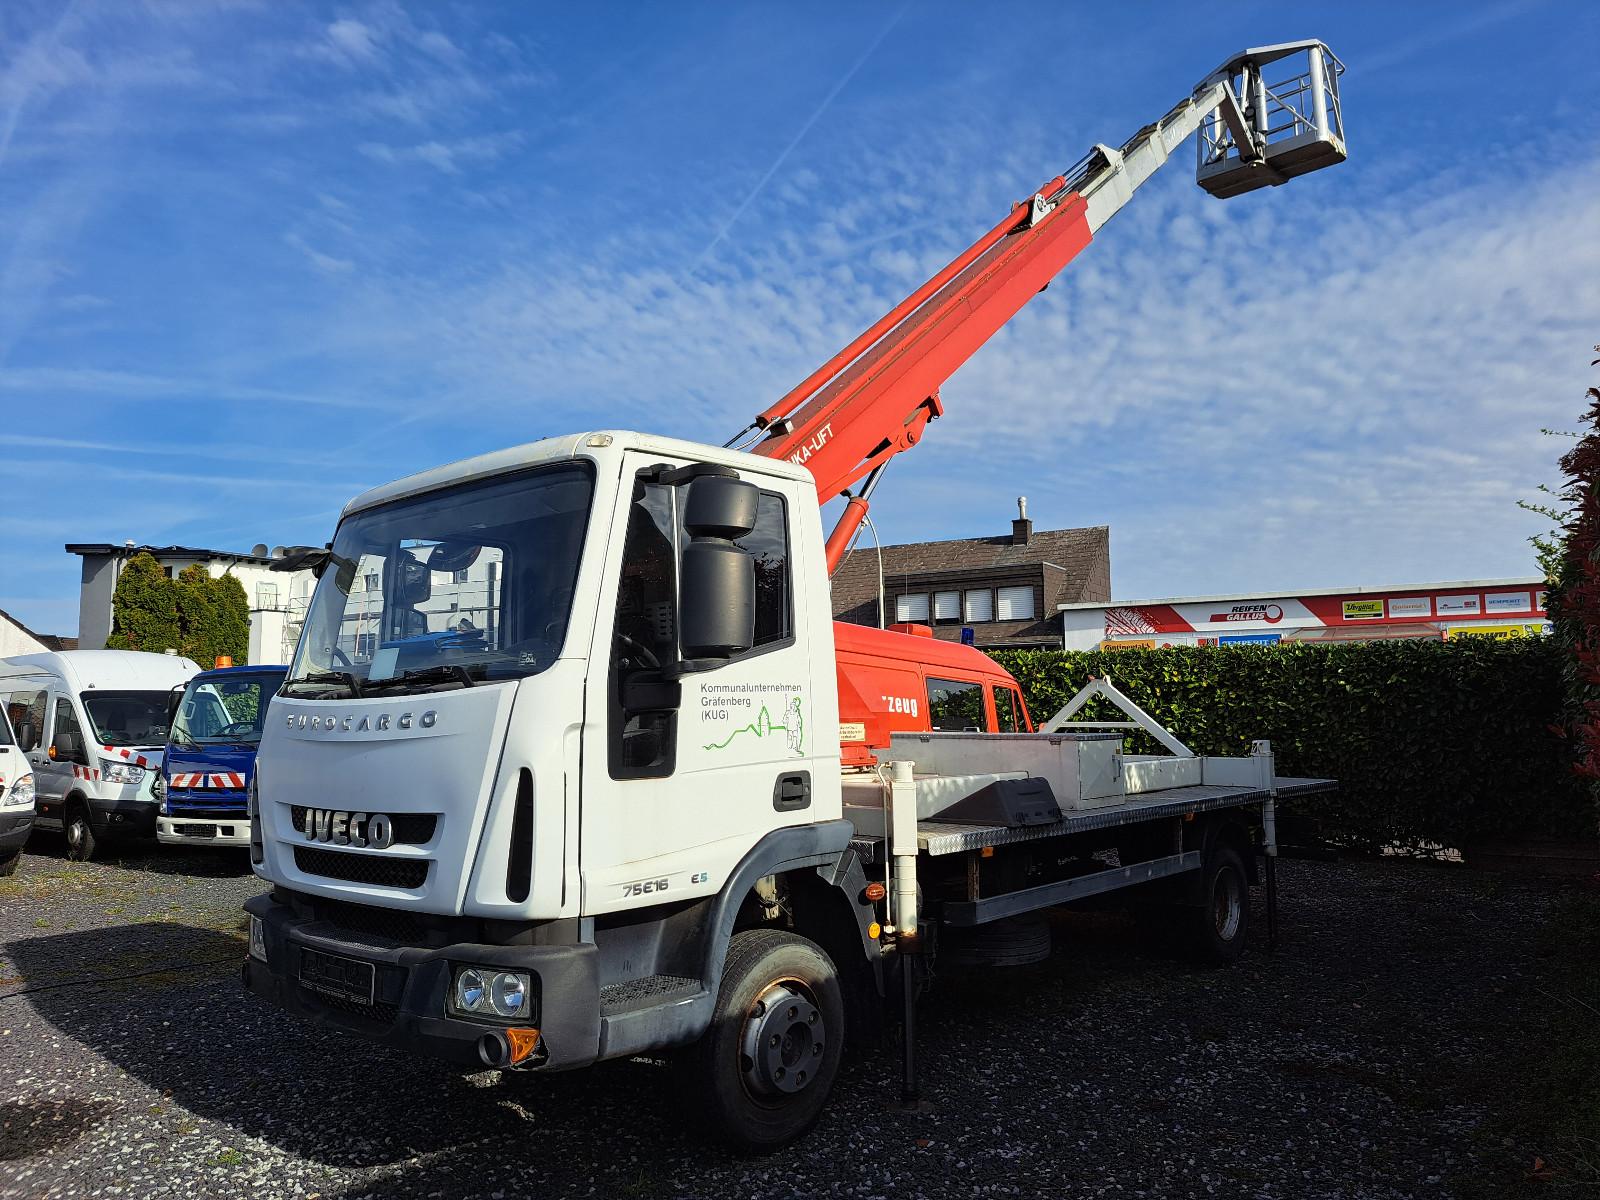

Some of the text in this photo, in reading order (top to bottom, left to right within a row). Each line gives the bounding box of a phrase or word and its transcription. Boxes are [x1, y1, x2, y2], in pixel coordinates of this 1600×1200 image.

[1231, 604, 1267, 612] REIFEN
[1226, 612, 1265, 621] GALLUS
[701, 683, 802, 693] Kommunalunternehmen
[701, 696, 751, 707] Gräfenberg
[881, 695, 918, 718] zeug
[286, 710, 438, 731] EUROCARGO
[701, 709, 729, 721] (KUG)
[304, 809, 393, 849] IVECO
[622, 872, 708, 898] 75E16 E5
